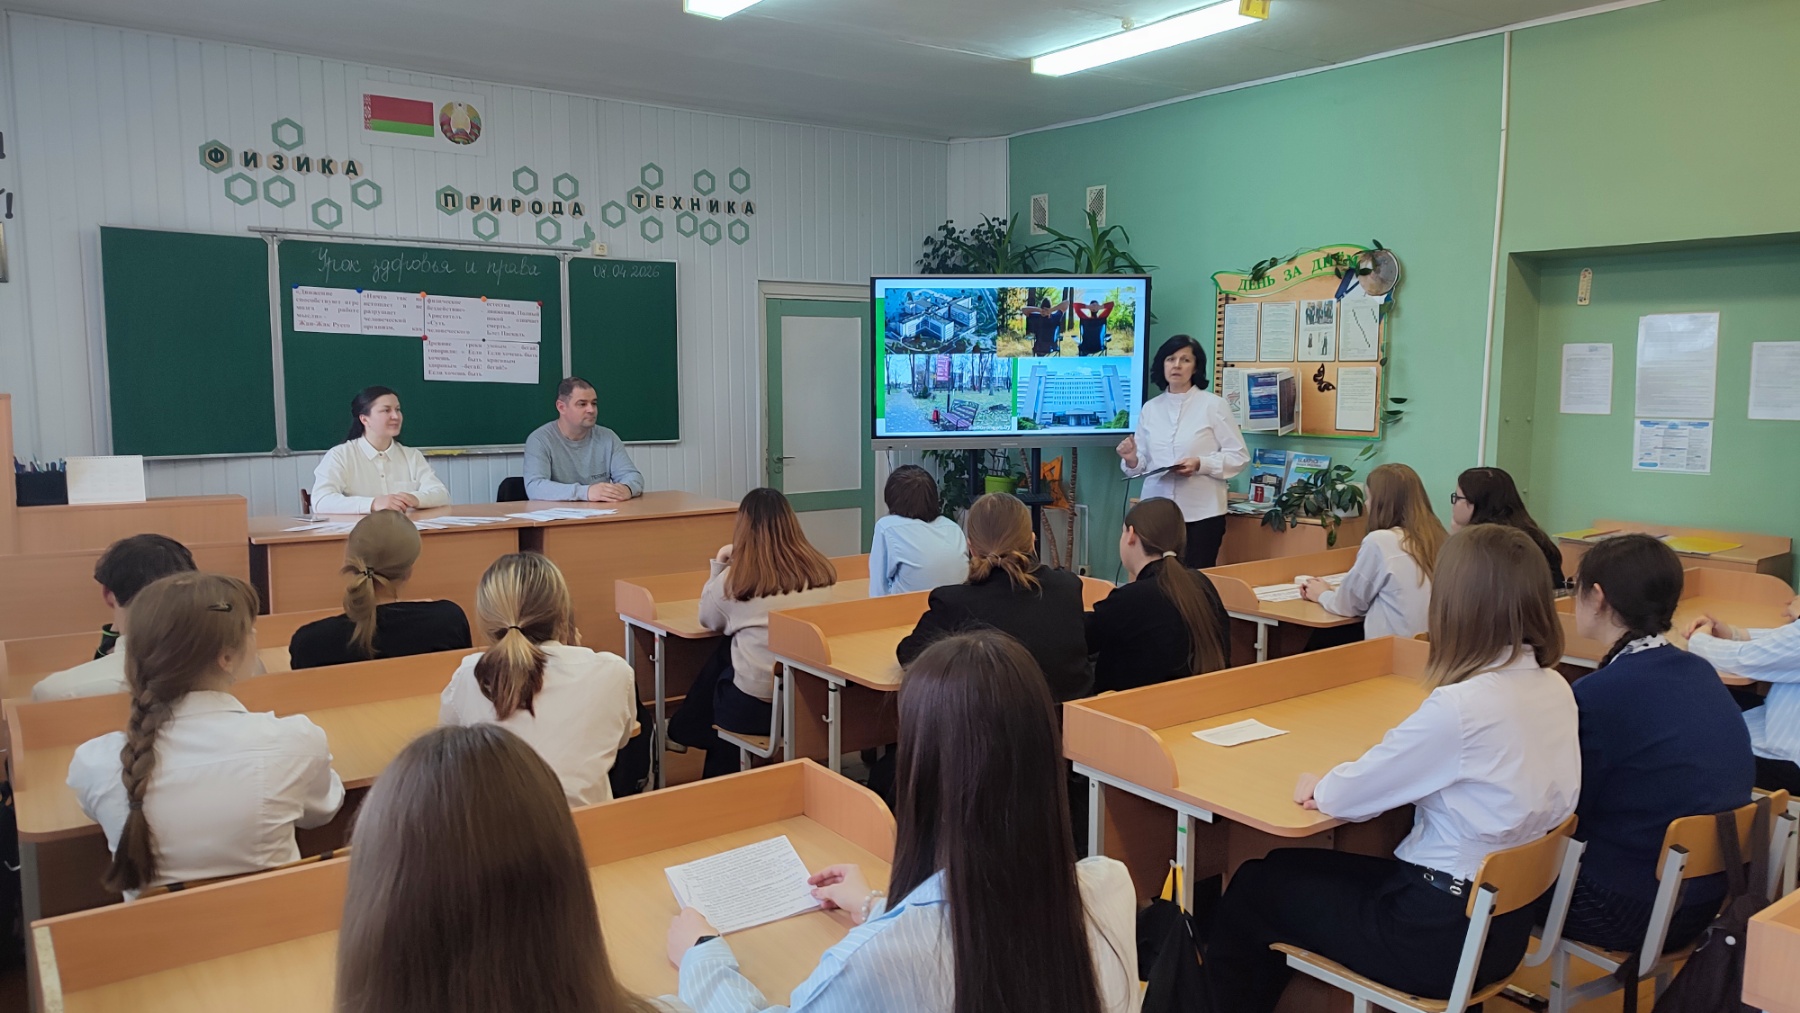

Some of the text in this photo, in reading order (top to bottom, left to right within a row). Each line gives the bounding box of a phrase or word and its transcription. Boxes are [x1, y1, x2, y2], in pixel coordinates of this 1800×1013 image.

[208, 148, 359, 176] ФИЗИКА
[444, 193, 583, 216] ПРИРОДА
[635, 194, 754, 215] ТЕХНИКА
[313, 247, 541, 285] Урок здоровья и права
[1238, 275, 1276, 292] ДЕНЬ
[1283, 265, 1302, 281] ЗА
